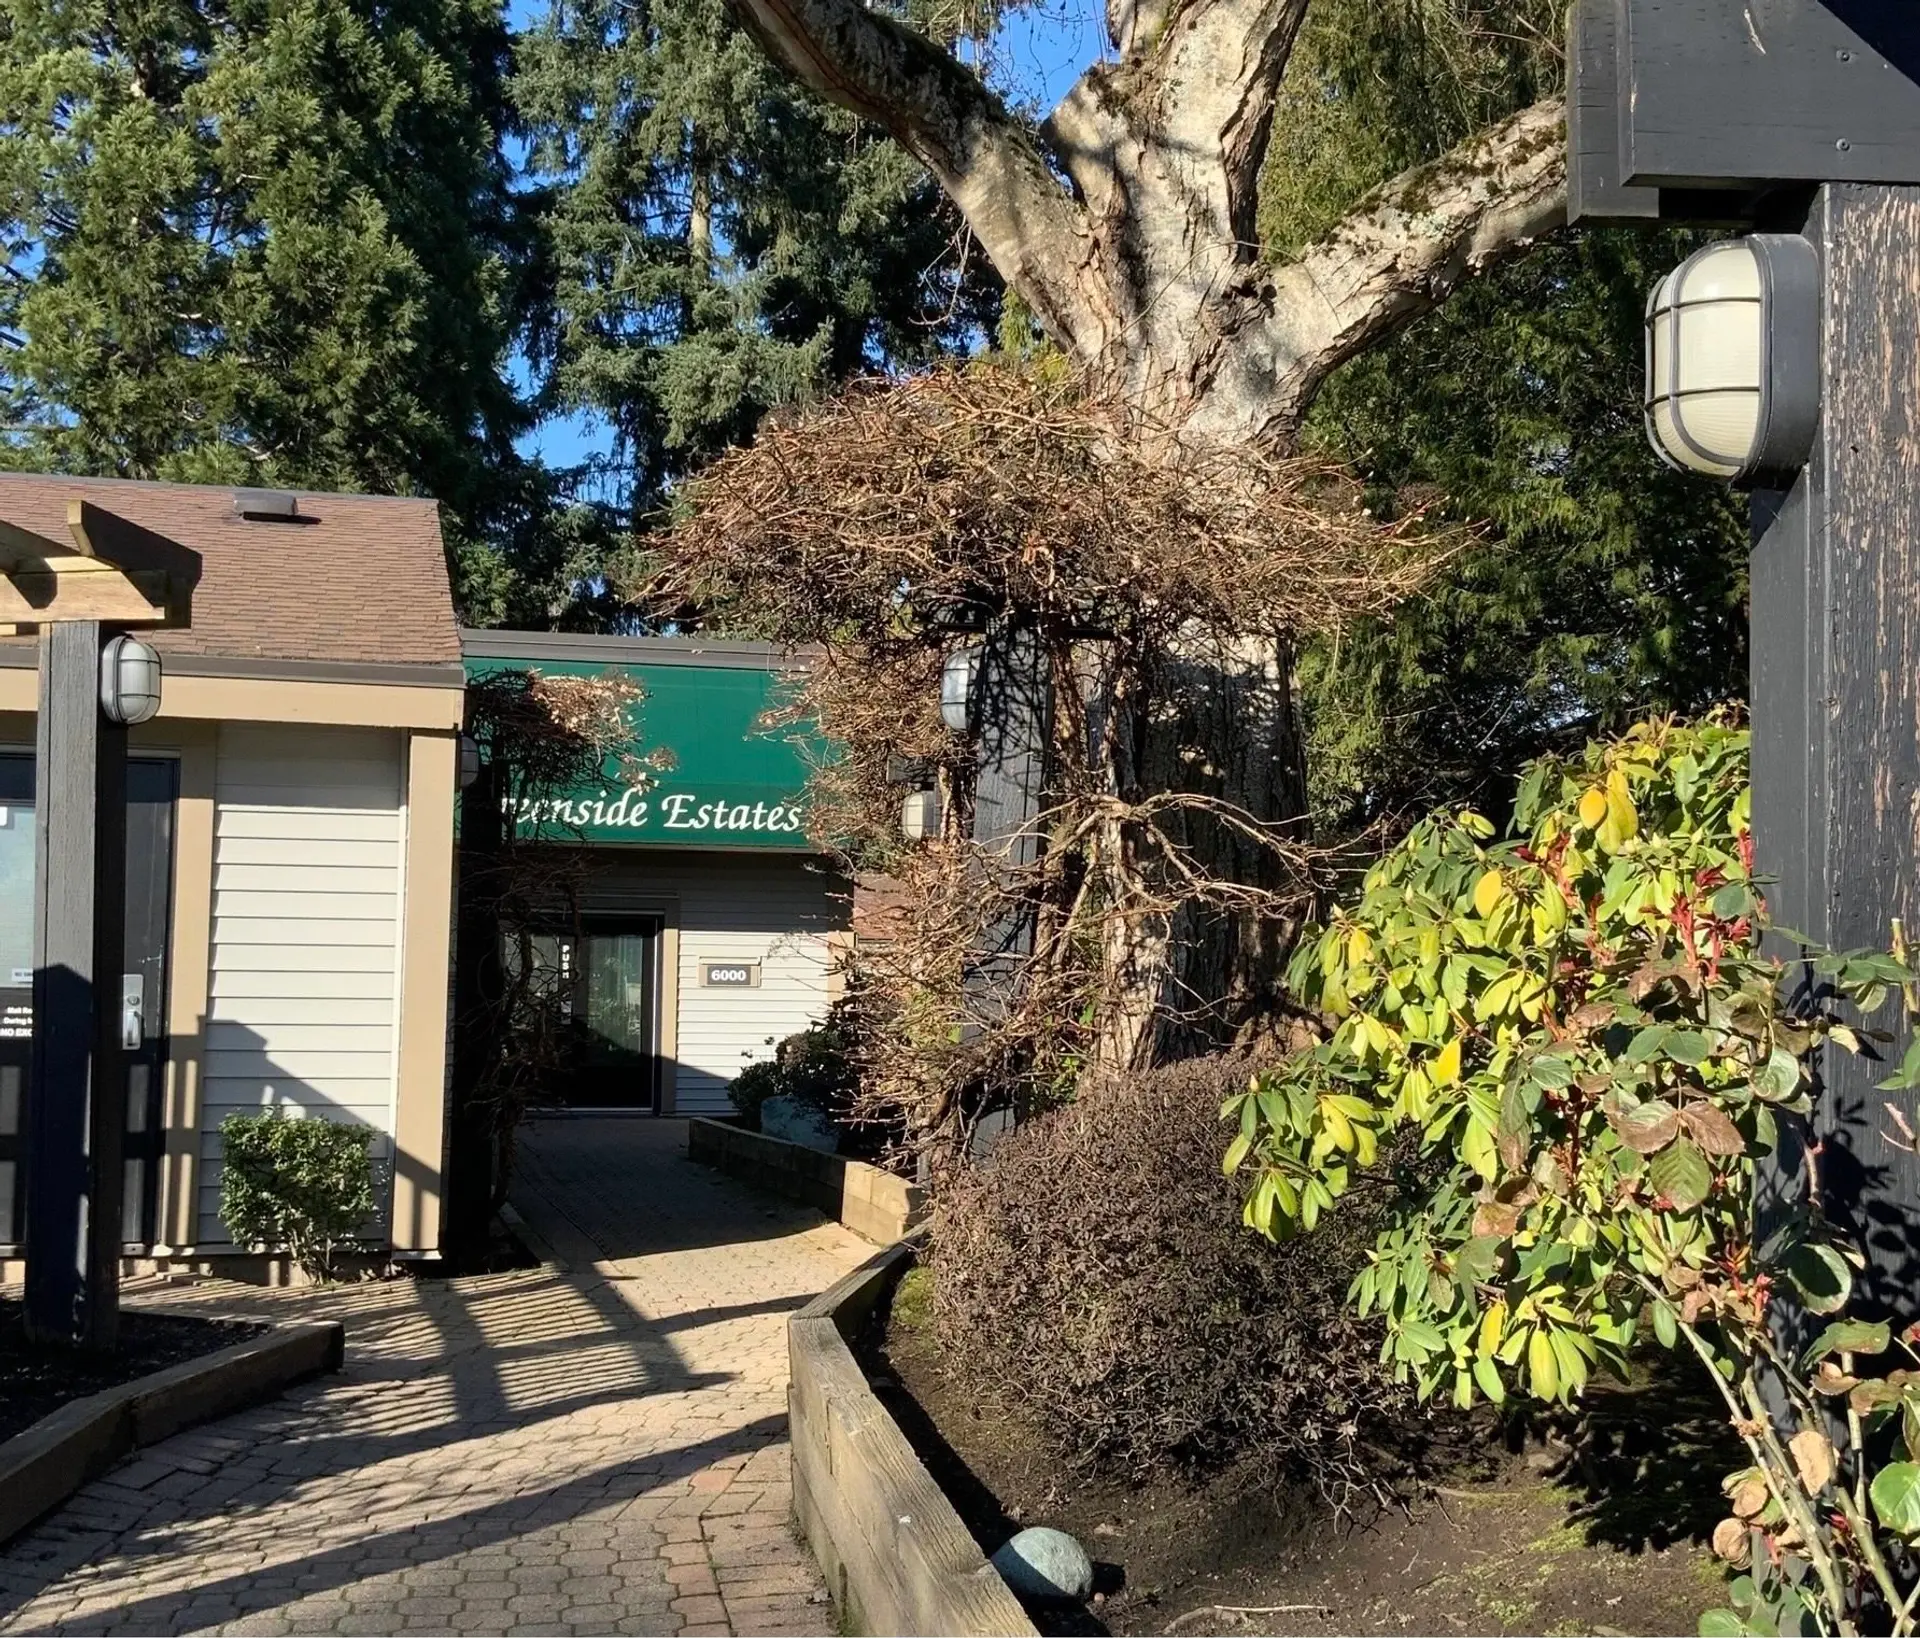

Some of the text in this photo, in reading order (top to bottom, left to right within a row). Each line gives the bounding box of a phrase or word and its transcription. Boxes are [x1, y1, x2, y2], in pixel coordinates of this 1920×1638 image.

[501, 787, 802, 831] reenside Estates
[562, 944, 570, 979] PUSH
[711, 969, 747, 981] 6000
